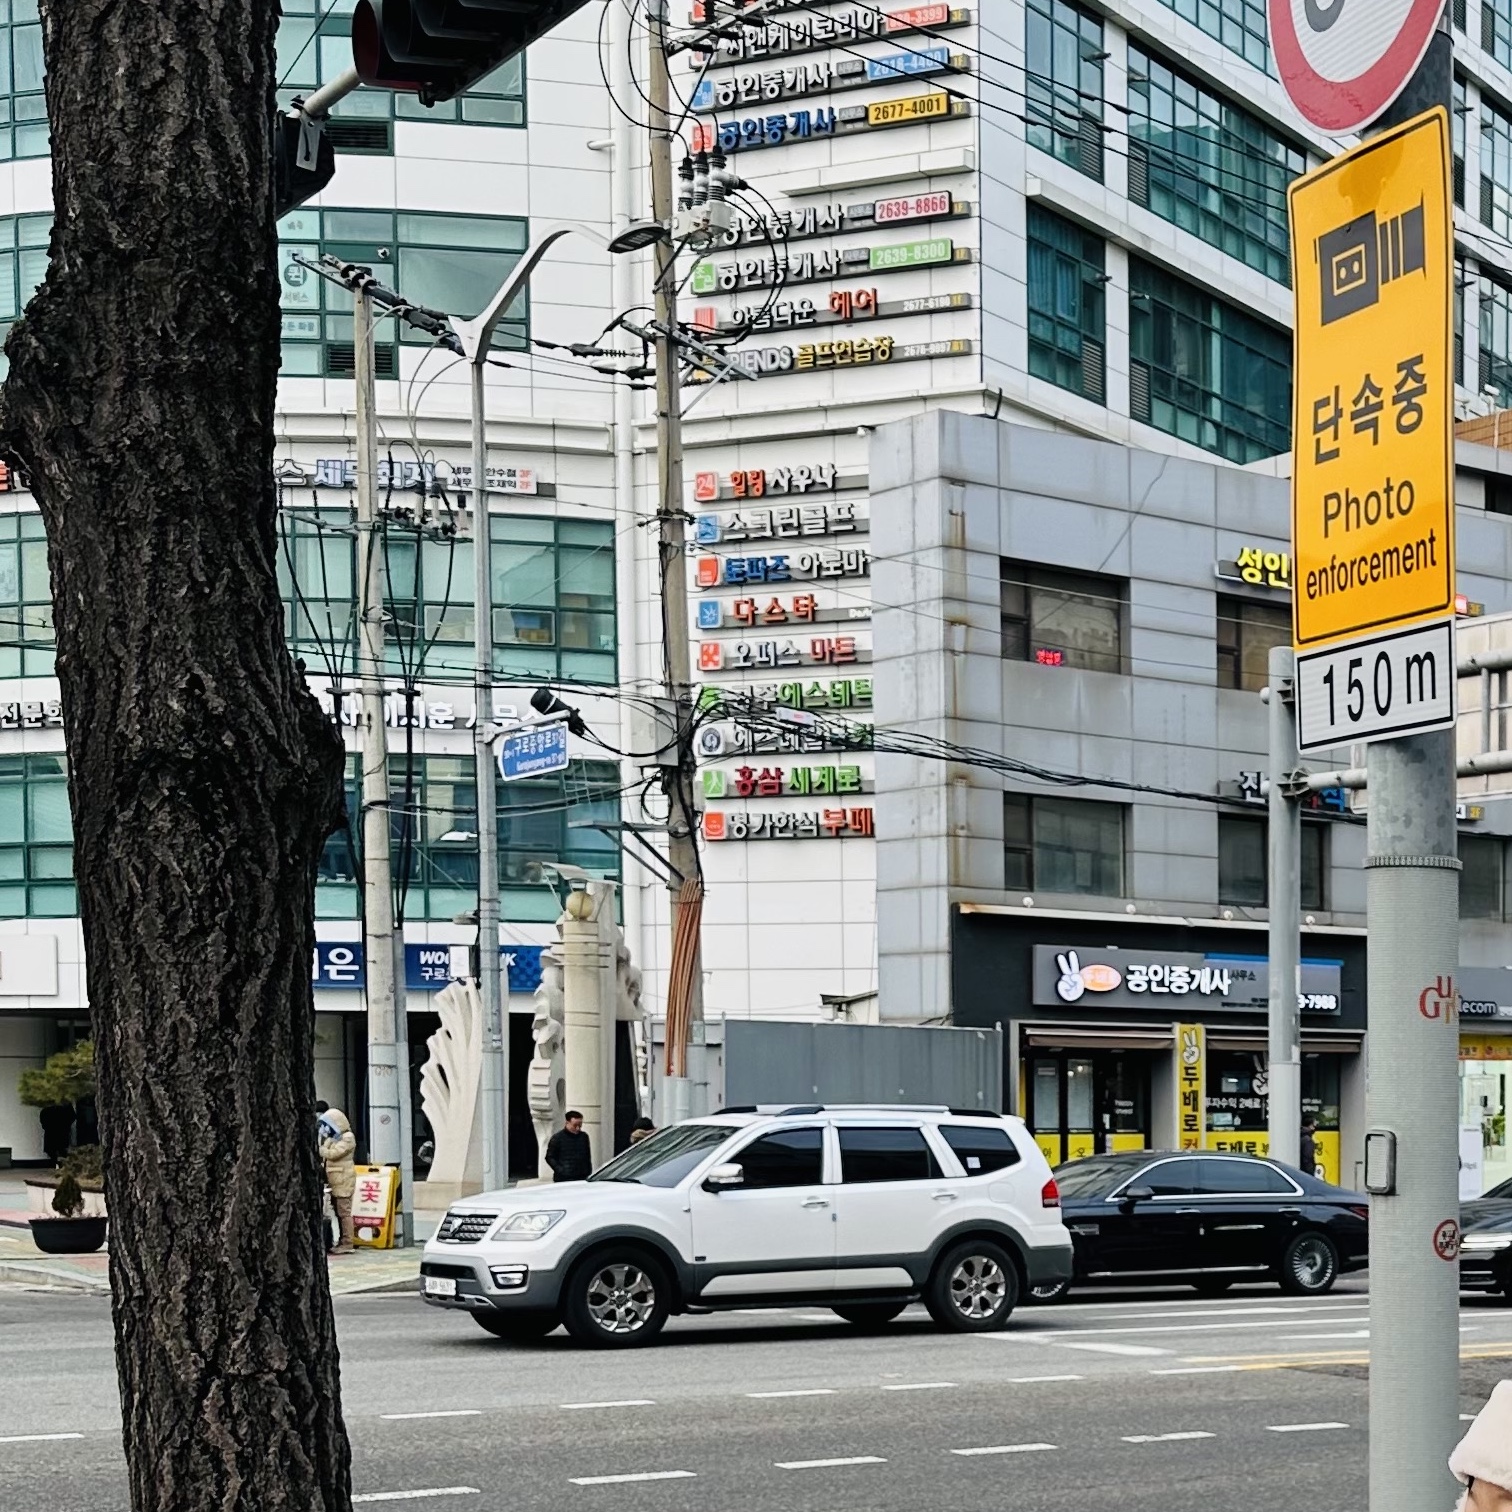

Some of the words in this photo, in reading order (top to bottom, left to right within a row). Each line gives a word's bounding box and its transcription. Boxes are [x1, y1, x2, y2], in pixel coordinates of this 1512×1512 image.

[716, 63, 834, 105] 공인중개사
[719, 107, 836, 149] 공인중개사
[874, 97, 941, 121] 2677-4001
[878, 195, 947, 219] 2639-8866
[718, 249, 841, 290] 공인중개사
[876, 242, 945, 266] 2639-8300
[731, 298, 817, 329] 아름다운
[829, 288, 879, 319] 헤어
[726, 346, 792, 373] RIENDS
[796, 336, 894, 368] 골프연습장
[1312, 353, 1427, 465] 단속중
[730, 469, 765, 497] 힐링
[771, 462, 838, 493] 사우나
[724, 503, 855, 540] 스크린골프
[1323, 476, 1415, 538] Photo
[725, 555, 792, 584] 토파즈
[797, 549, 871, 578] 아로마
[1306, 528, 1437, 600] enforcement
[732, 639, 802, 669] 오피스
[810, 636, 857, 664] 마트
[1323, 650, 1392, 726] 150
[1406, 648, 1437, 704] m
[735, 765, 784, 796] 홍삼
[789, 765, 862, 793] 세계로
[730, 811, 819, 839] 명가한식
[823, 807, 873, 837] 부페
[1126, 963, 1233, 996] 공인중개사
[1182, 1066, 1200, 1132] 두배로
